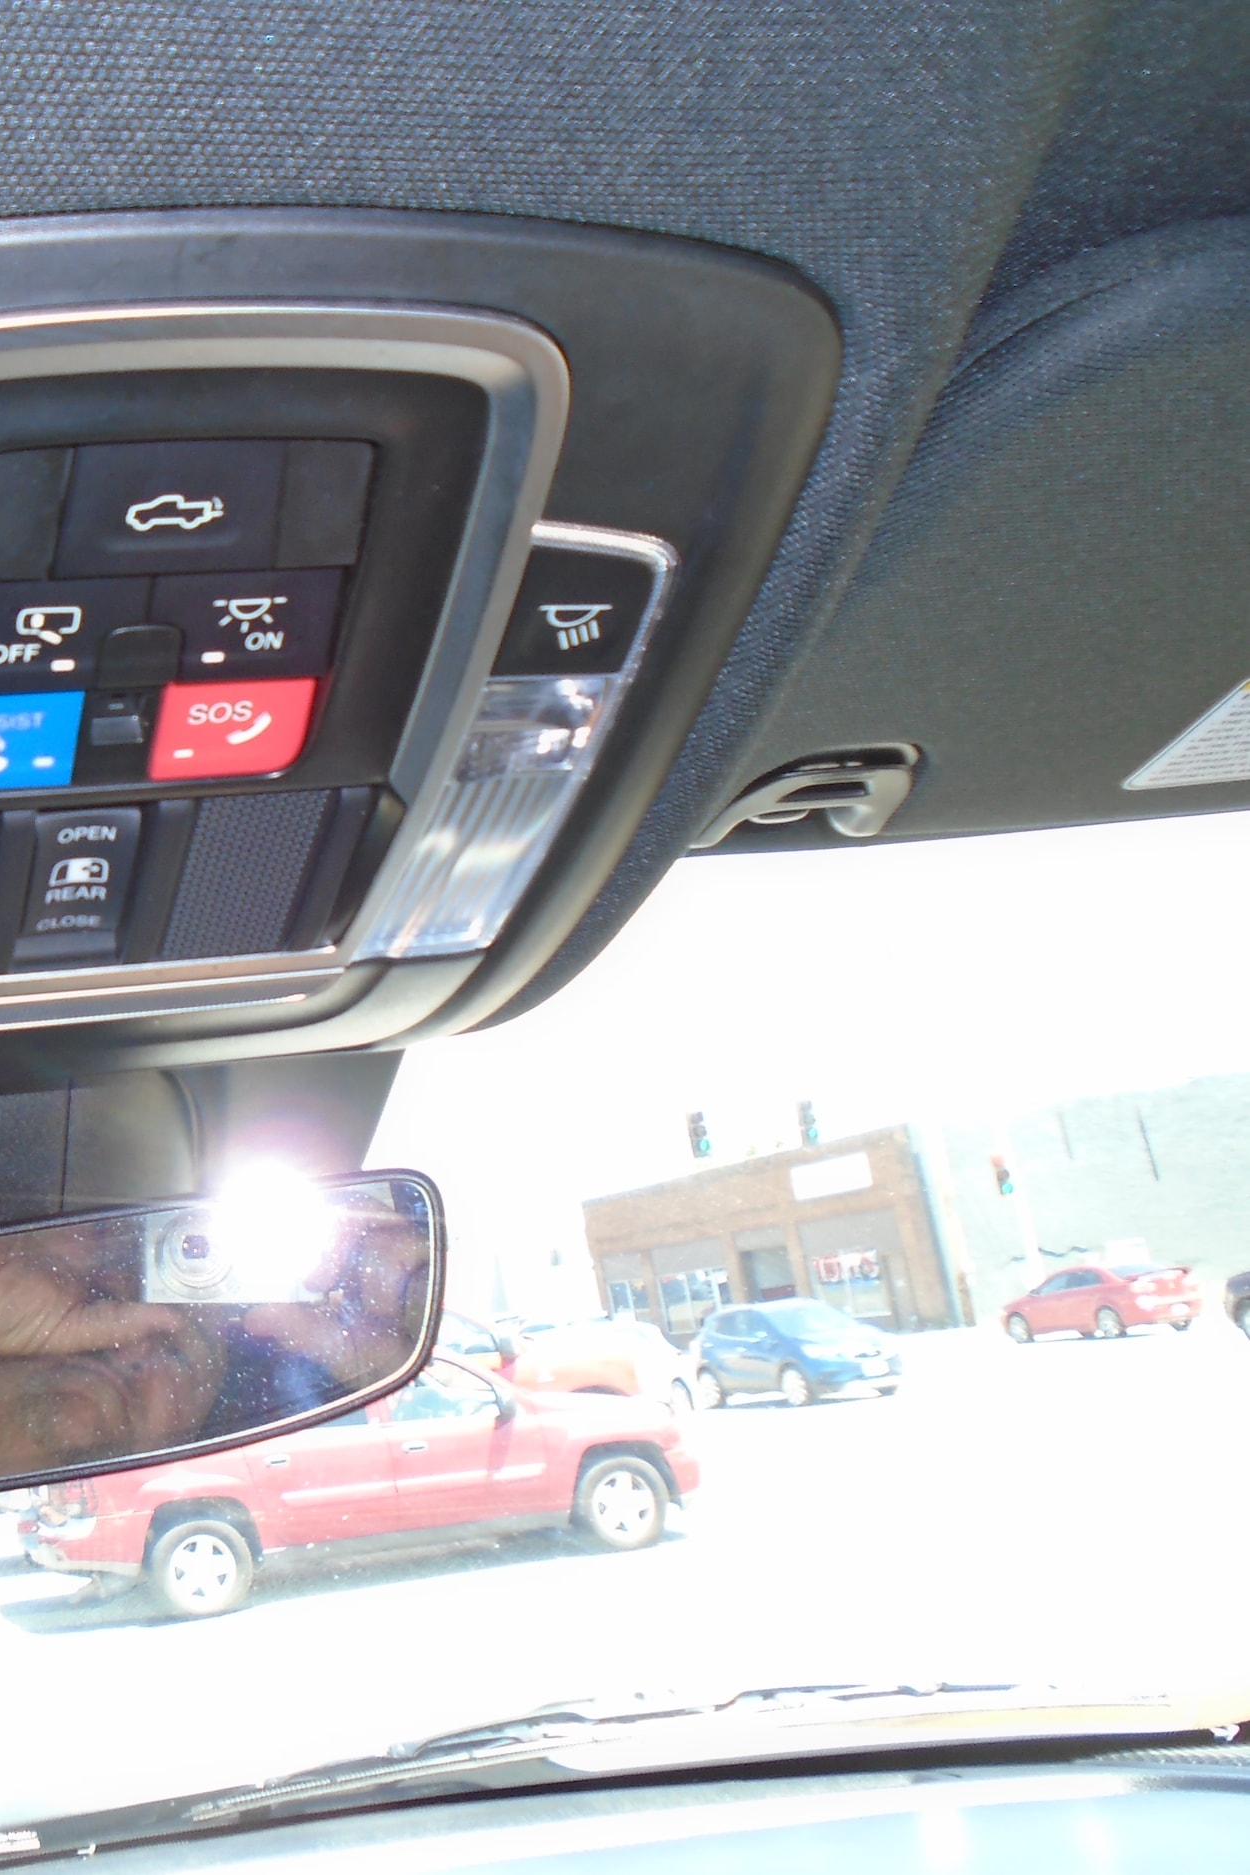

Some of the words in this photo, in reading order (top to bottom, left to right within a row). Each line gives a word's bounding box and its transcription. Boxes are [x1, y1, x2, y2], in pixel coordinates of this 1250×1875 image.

[245, 631, 285, 651] ON
[187, 700, 254, 726] SOS
[57, 825, 117, 845] OPEN
[45, 886, 107, 904] REAR
[36, 914, 101, 931] CLOSE
